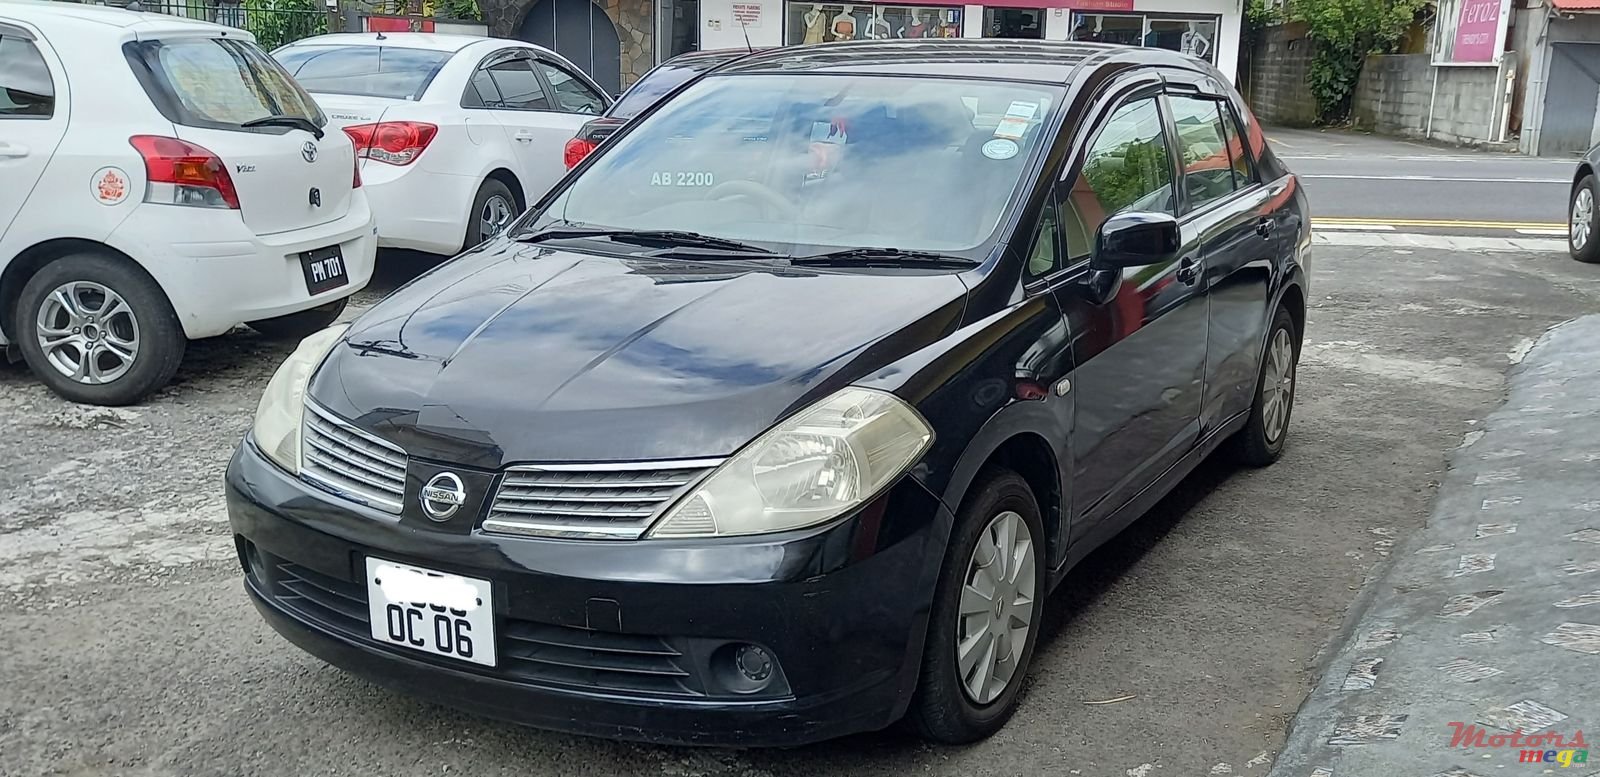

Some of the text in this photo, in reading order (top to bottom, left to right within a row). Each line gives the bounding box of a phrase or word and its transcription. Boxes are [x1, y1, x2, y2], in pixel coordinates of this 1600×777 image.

[650, 172, 714, 186] AB 2200
[311, 256, 343, 283] PM 701
[424, 488, 459, 502] NISSAN
[387, 603, 473, 658] OC 06
